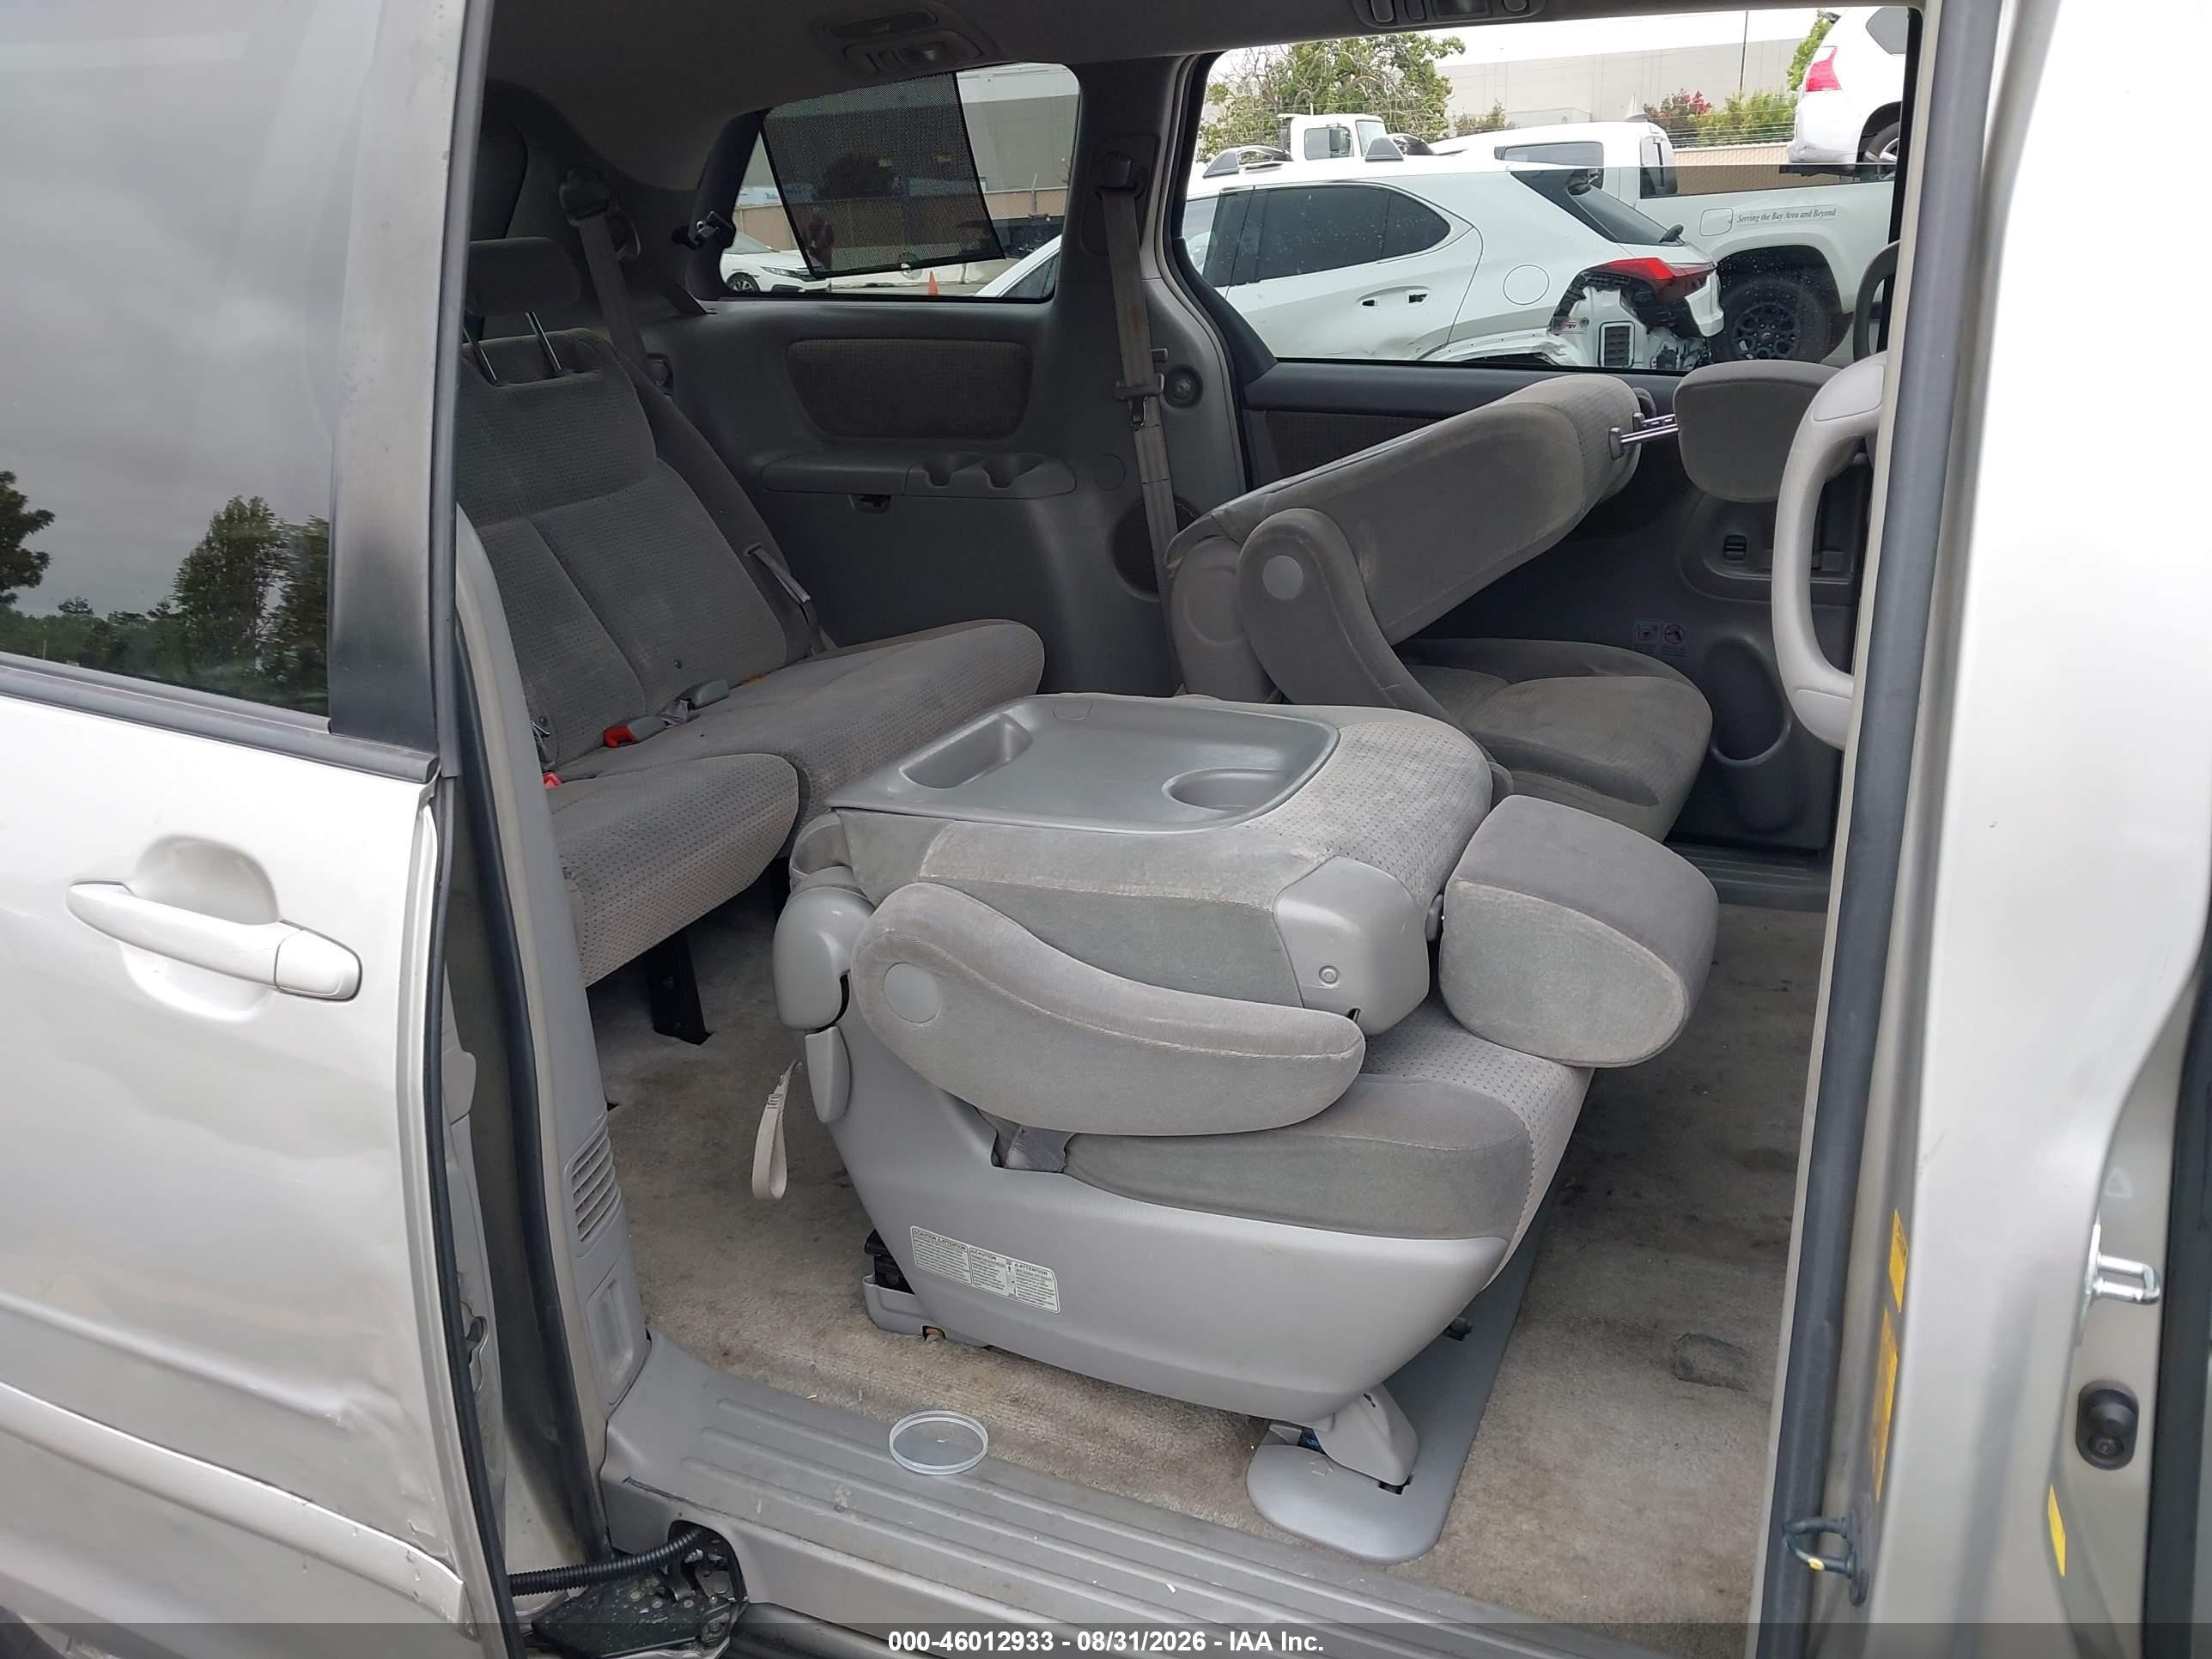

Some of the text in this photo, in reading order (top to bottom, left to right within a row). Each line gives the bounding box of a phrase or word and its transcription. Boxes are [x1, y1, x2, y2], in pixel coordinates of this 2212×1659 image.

[1737, 214, 1759, 222] Serving
[1771, 211, 1784, 221] Bay
[1800, 210, 1813, 218] and
[1814, 208, 1837, 218] Beyond
[1019, 1263, 1048, 1276] ATTENTION
